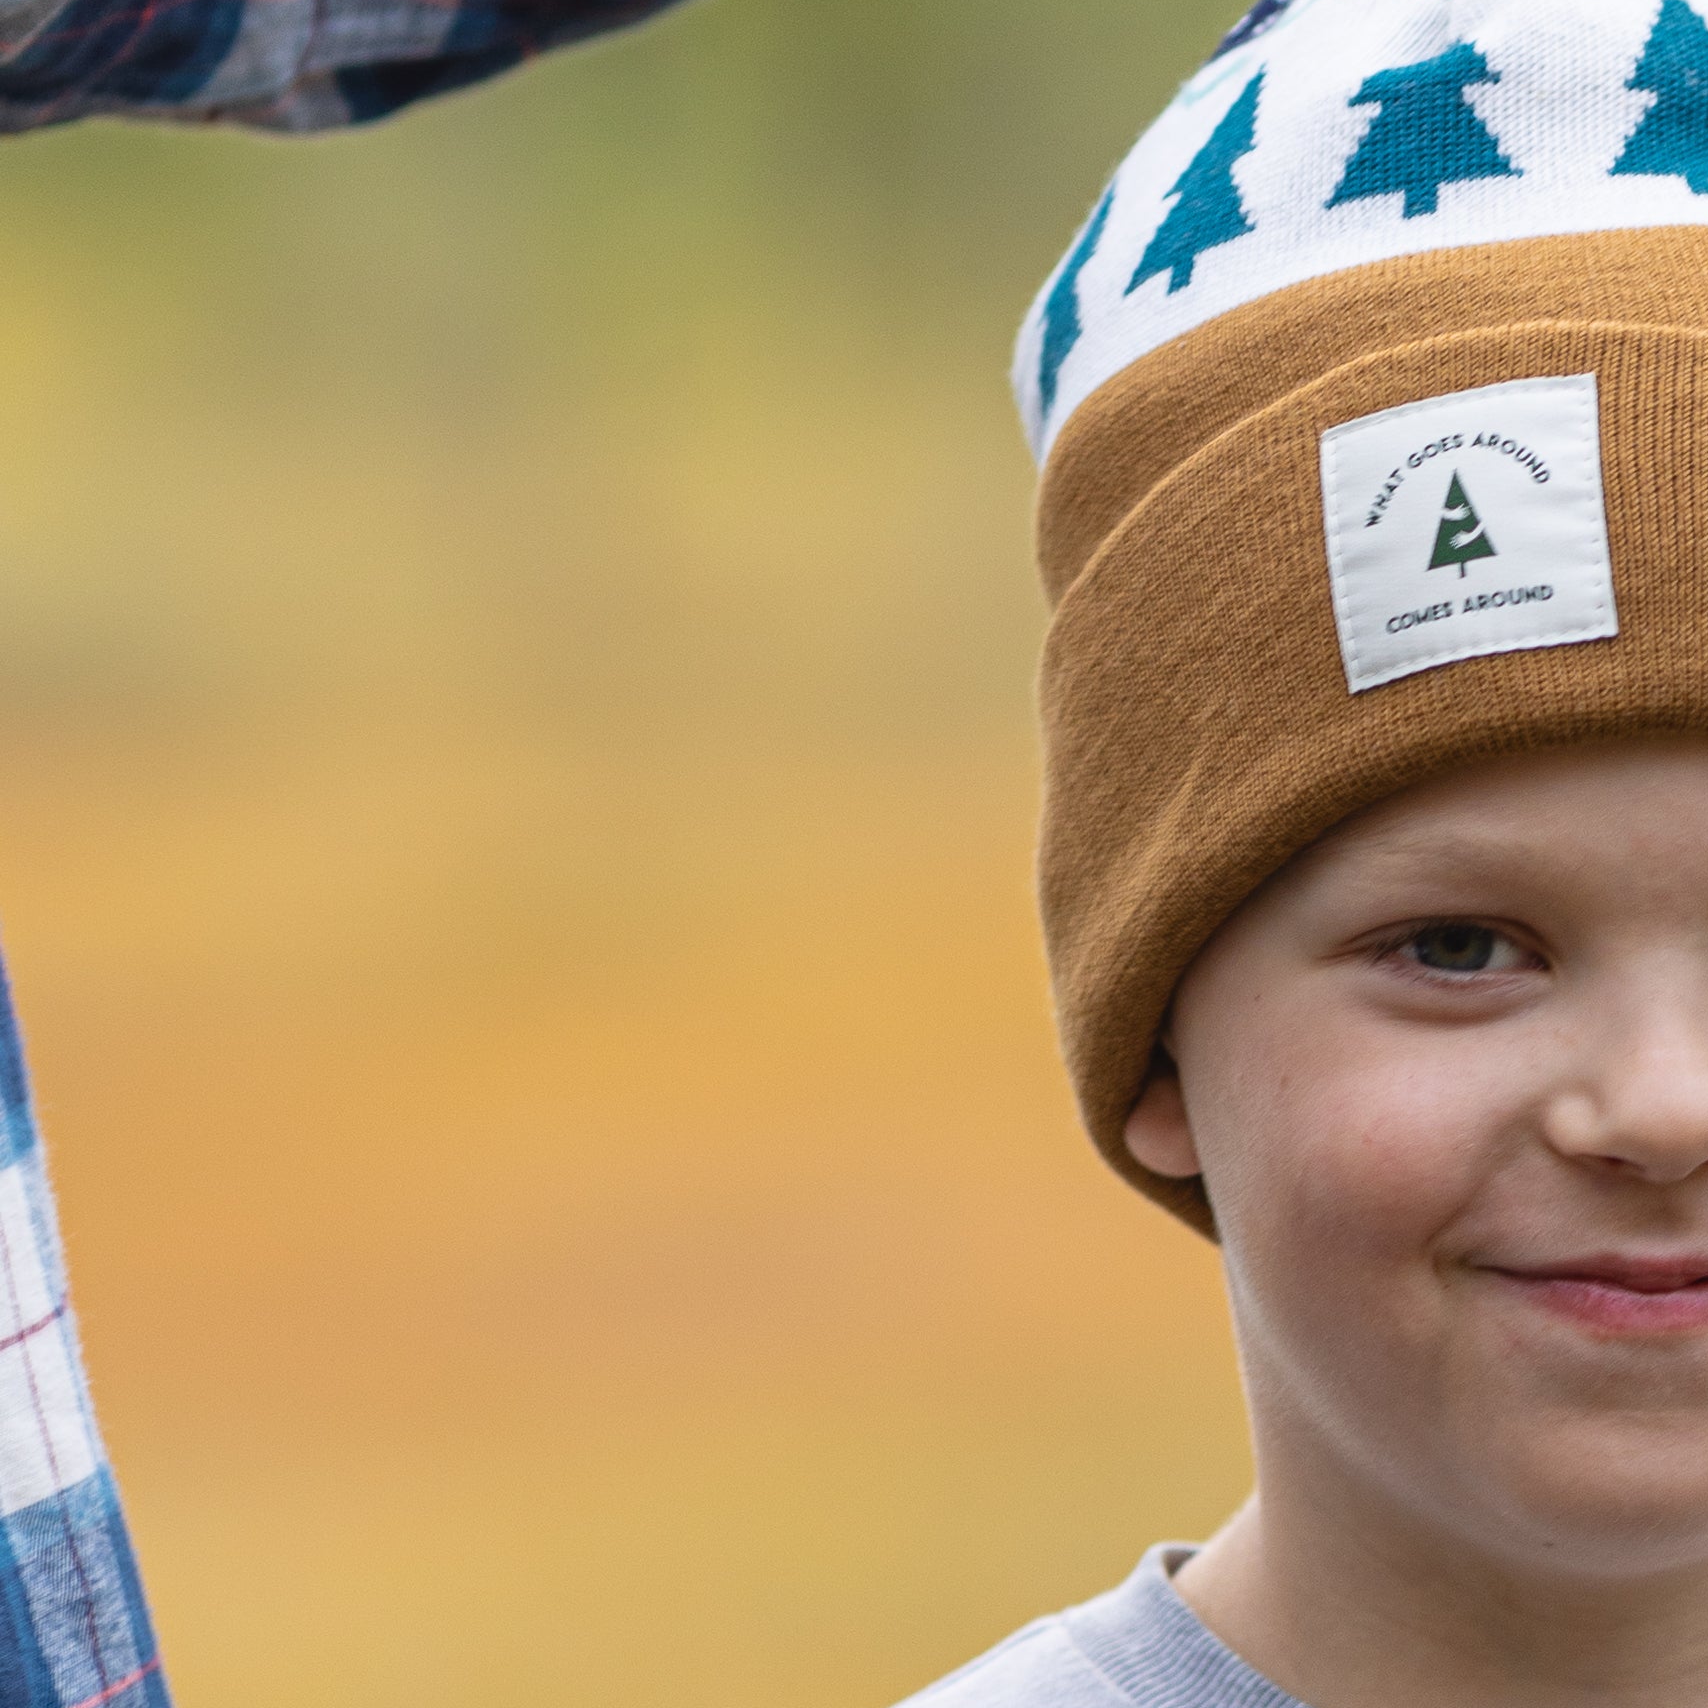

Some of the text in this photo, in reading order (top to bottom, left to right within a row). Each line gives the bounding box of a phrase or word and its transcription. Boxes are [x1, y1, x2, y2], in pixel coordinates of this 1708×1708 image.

[1364, 430, 1551, 528] WHAT GOES AROUND
[1386, 584, 1554, 634] COMES AROUND
